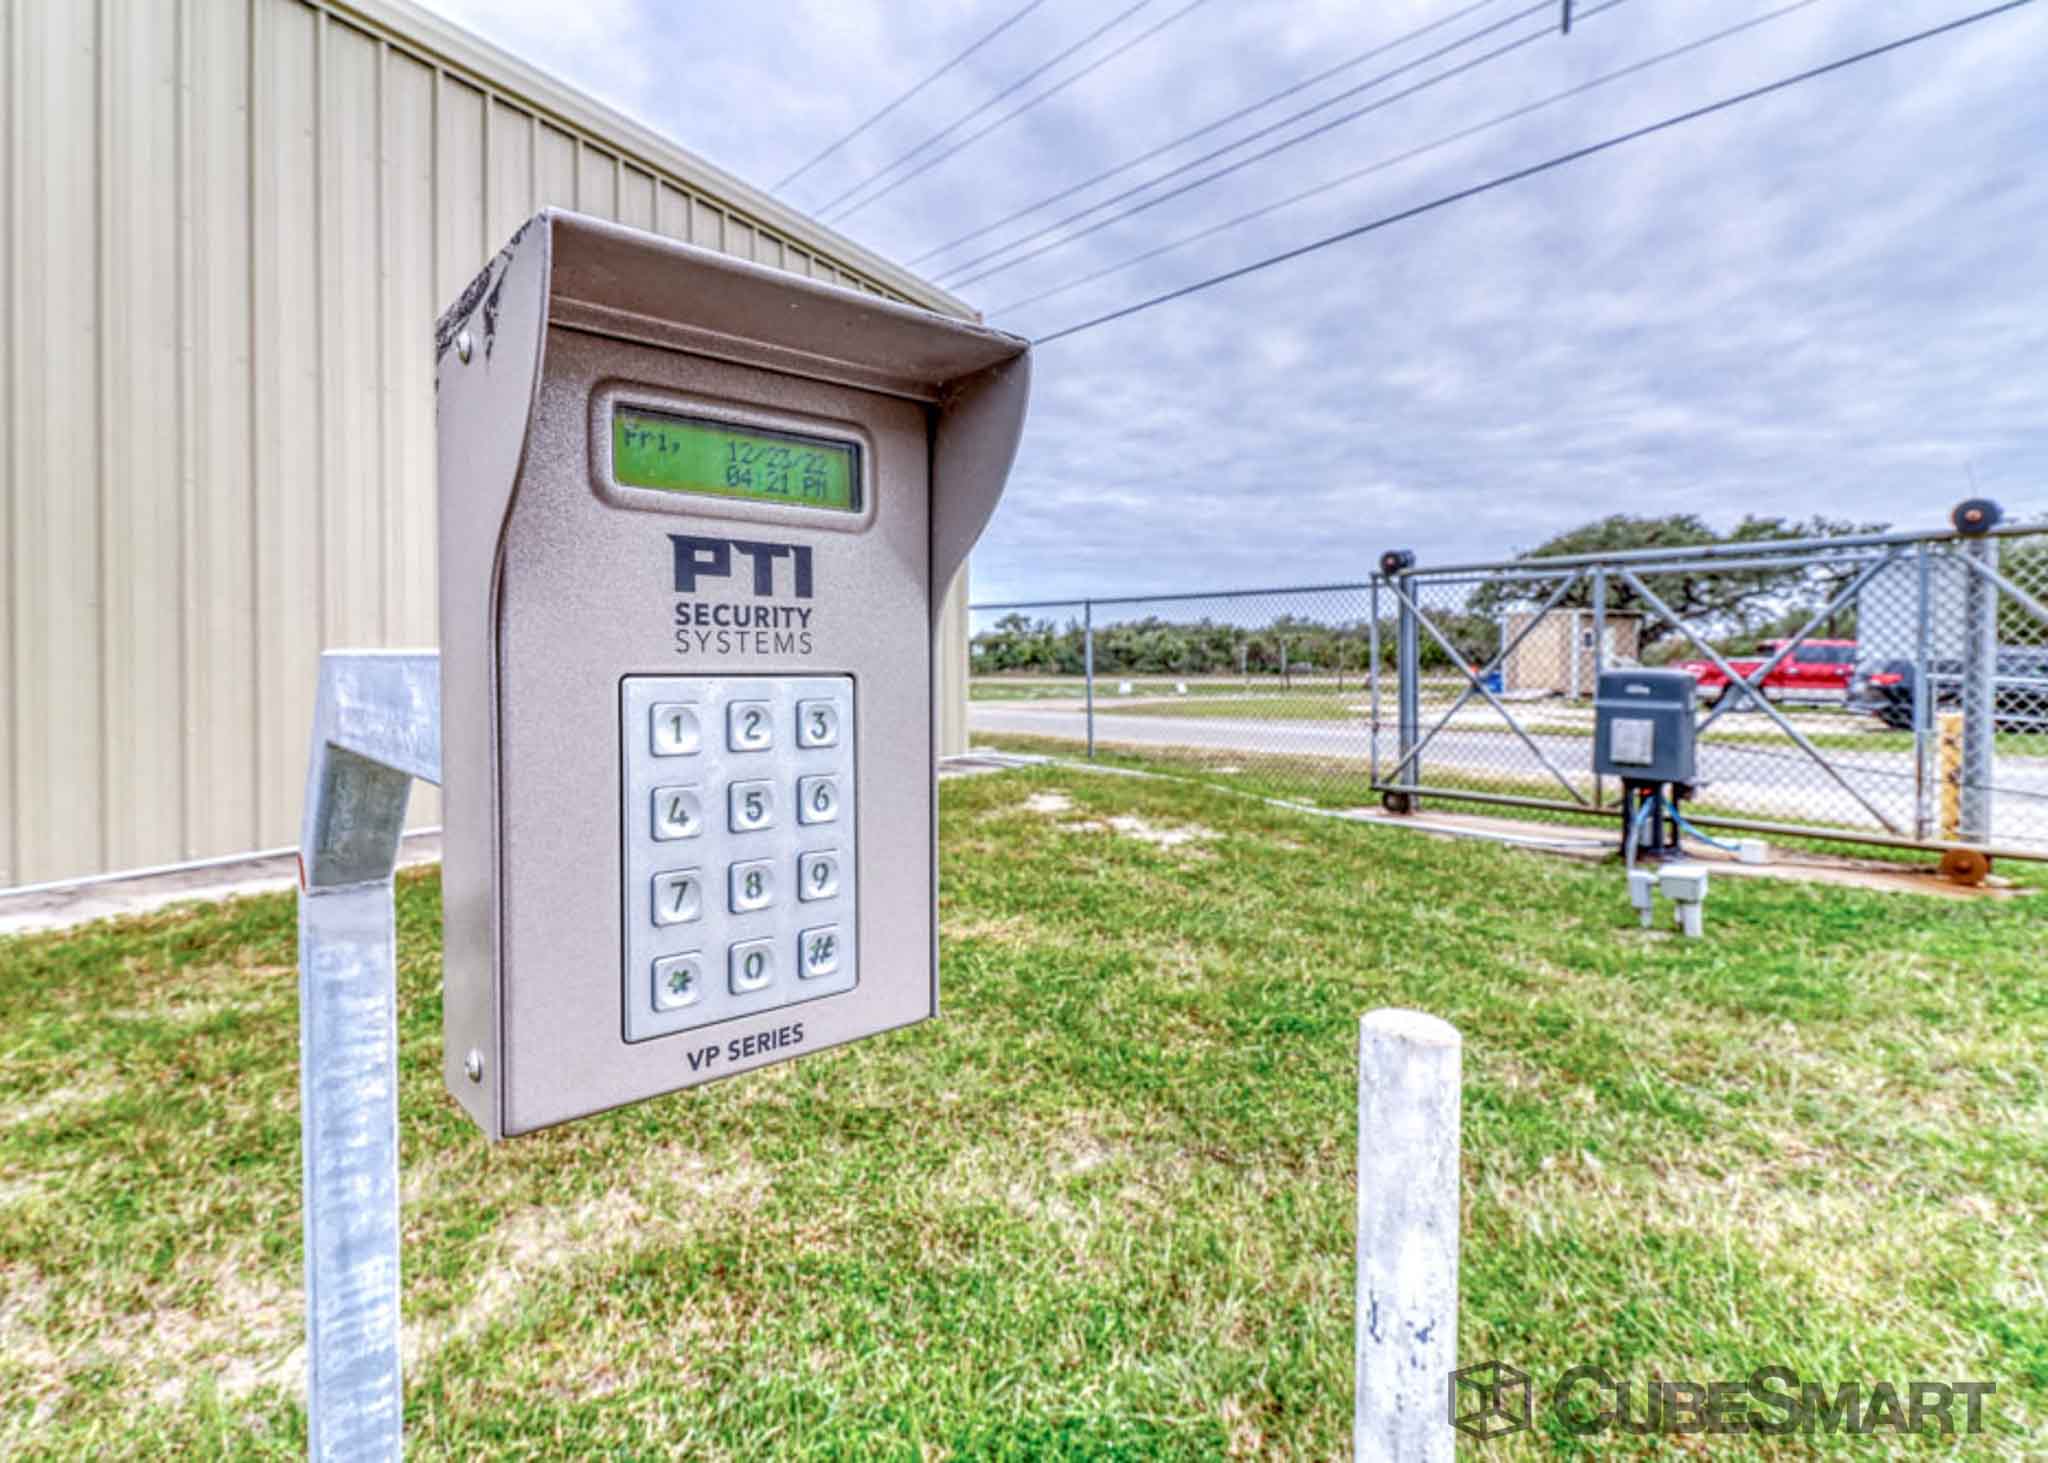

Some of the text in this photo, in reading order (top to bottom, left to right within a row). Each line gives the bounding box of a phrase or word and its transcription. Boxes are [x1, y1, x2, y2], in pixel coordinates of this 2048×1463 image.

[726, 464, 788, 494] 04:21
[666, 533, 813, 599] PTI
[675, 602, 813, 629] SECURITY
[675, 629, 813, 655] SYSTEMS
[671, 710, 828, 744] 1 2 3
[668, 784, 830, 827] 4 5 6
[670, 862, 829, 913] 7 8 9
[745, 951, 763, 980] 0
[686, 1023, 804, 1072] VP SERIES
